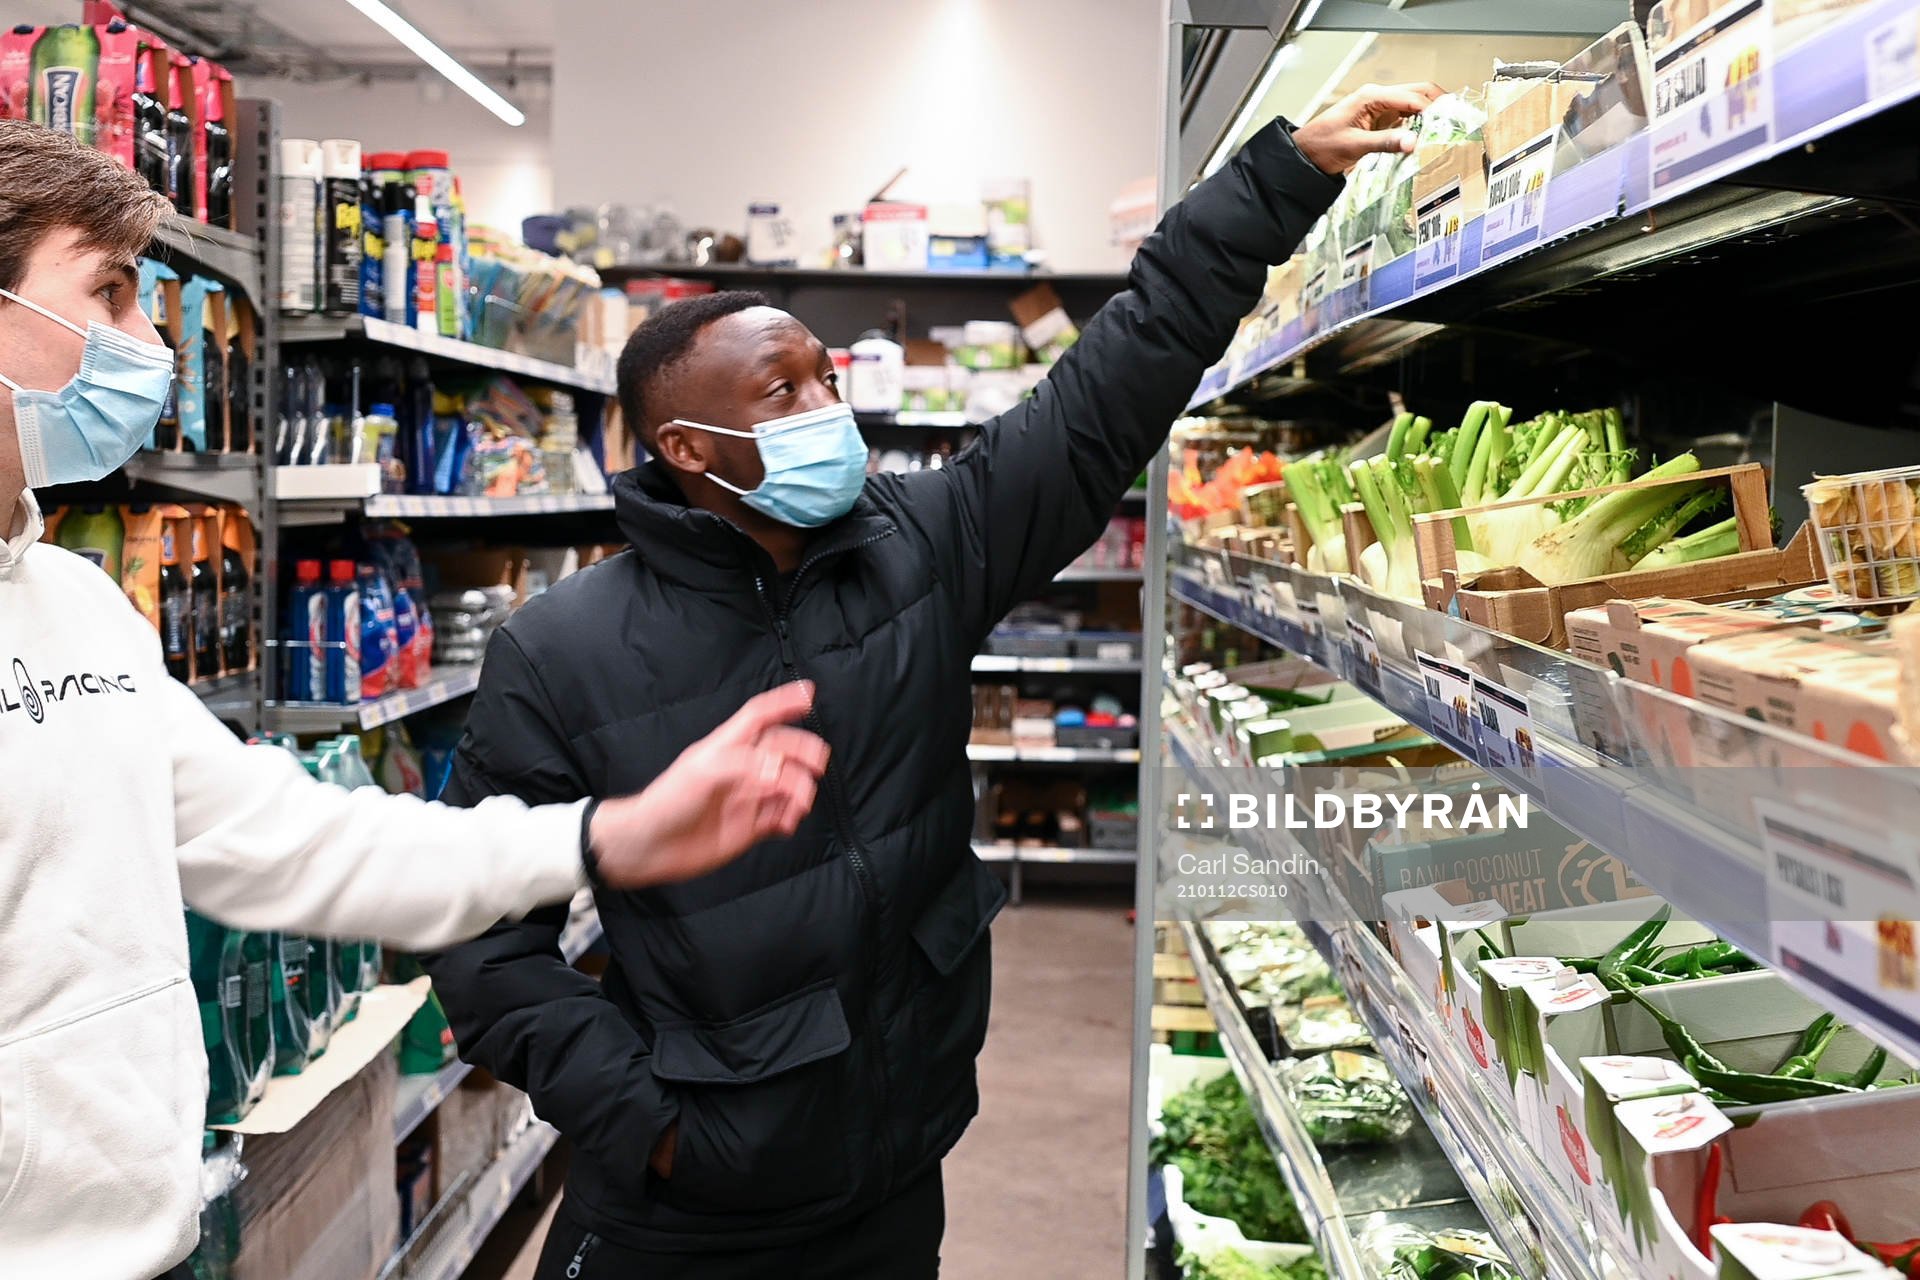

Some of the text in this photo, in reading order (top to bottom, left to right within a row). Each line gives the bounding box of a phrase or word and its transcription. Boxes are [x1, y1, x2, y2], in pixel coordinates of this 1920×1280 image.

[41, 672, 137, 703] RACING
[1400, 848, 1541, 889] RAW COCONUT
[1490, 877, 1546, 914] MEAT
